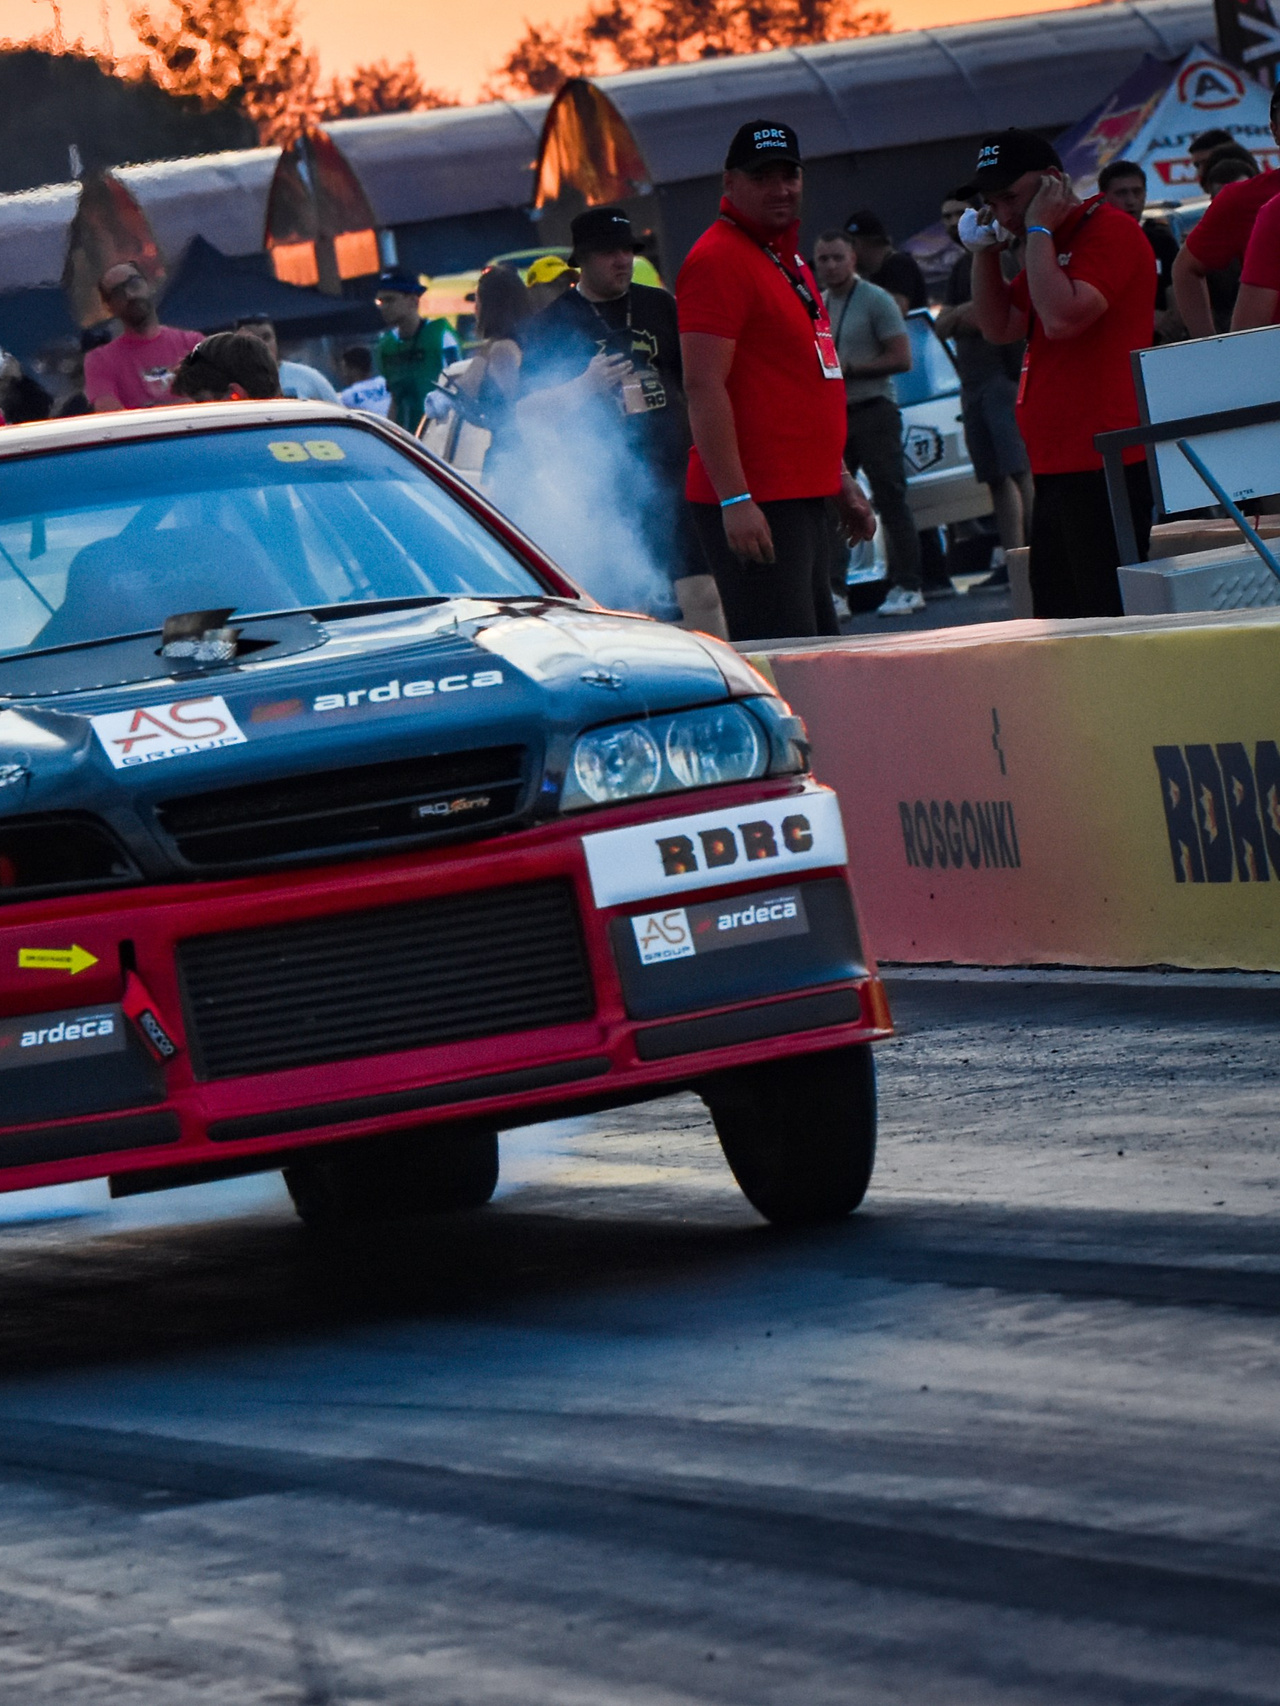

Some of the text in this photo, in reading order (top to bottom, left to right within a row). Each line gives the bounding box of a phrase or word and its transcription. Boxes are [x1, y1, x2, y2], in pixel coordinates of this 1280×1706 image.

[753, 128, 786, 141] RDRC
[755, 140, 788, 149] Official
[267, 440, 346, 462] 88
[313, 669, 503, 711] ardeca
[112, 695, 227, 754] AS
[122, 736, 239, 766] GROUP
[655, 814, 814, 877] RDRC
[898, 799, 1020, 869] ROSGONKI
[640, 911, 686, 949] AS
[717, 902, 797, 931] ardeca
[644, 946, 690, 961] GROUP
[20, 1019, 114, 1047] ardeca
